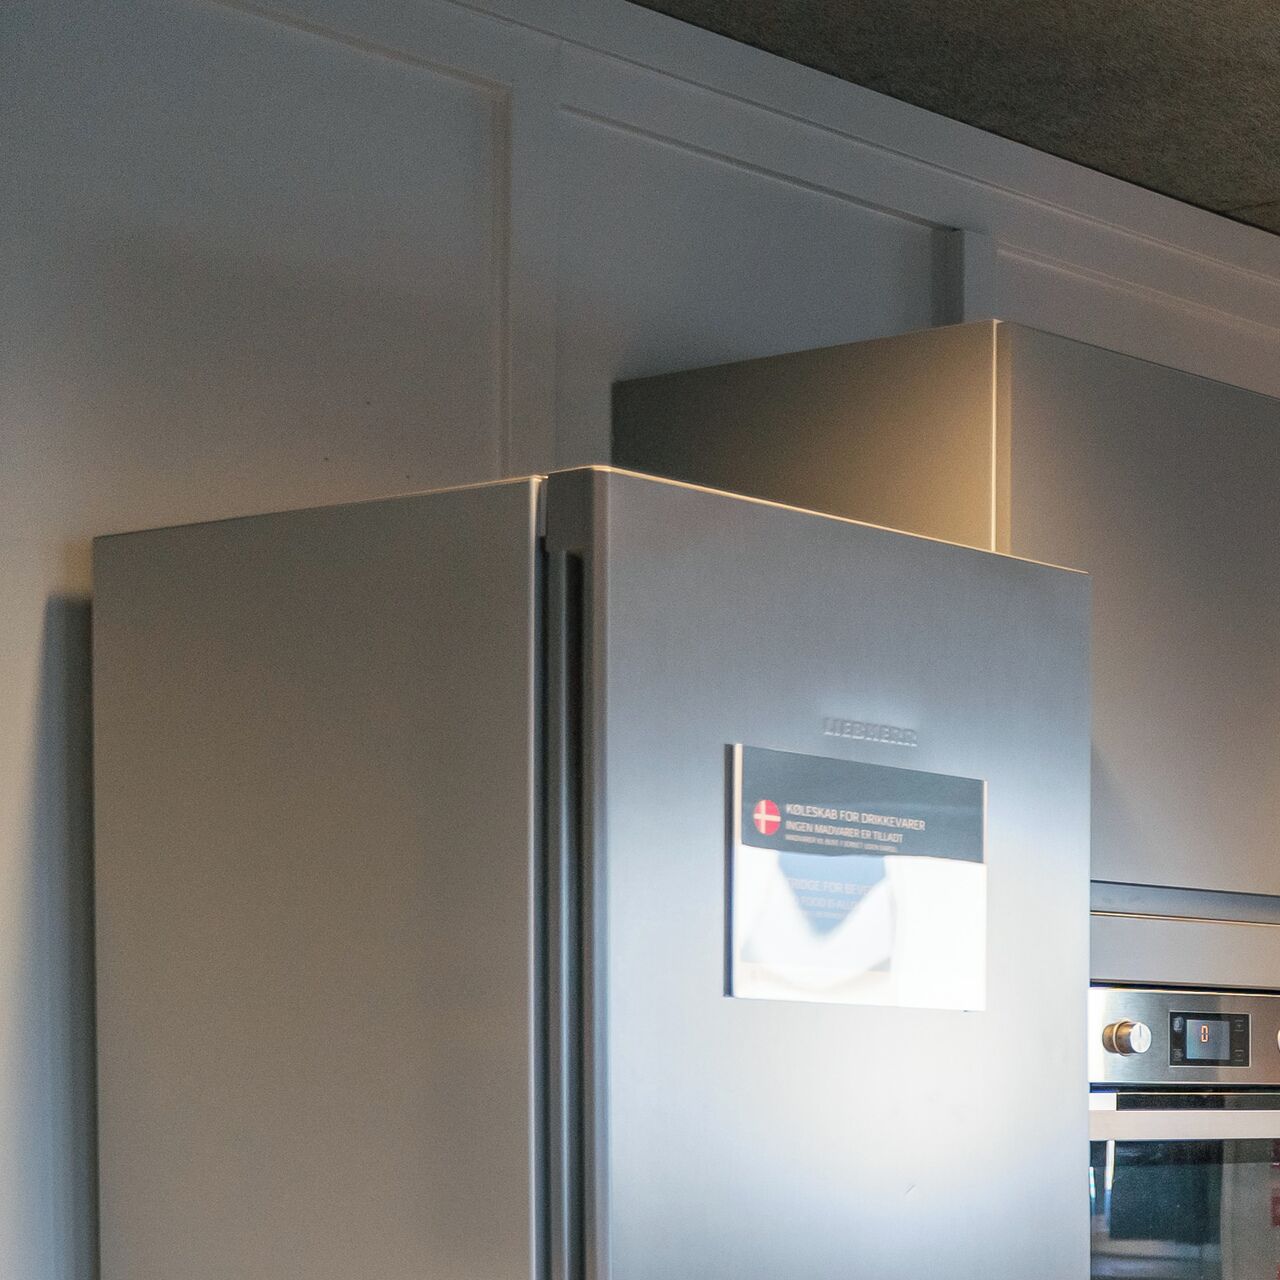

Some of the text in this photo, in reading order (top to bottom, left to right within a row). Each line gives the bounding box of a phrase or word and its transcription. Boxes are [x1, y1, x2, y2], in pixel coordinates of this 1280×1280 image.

[785, 803, 926, 831] KØLESKAB FOR DRIKKEVARER
[785, 820, 813, 833] INGEN
